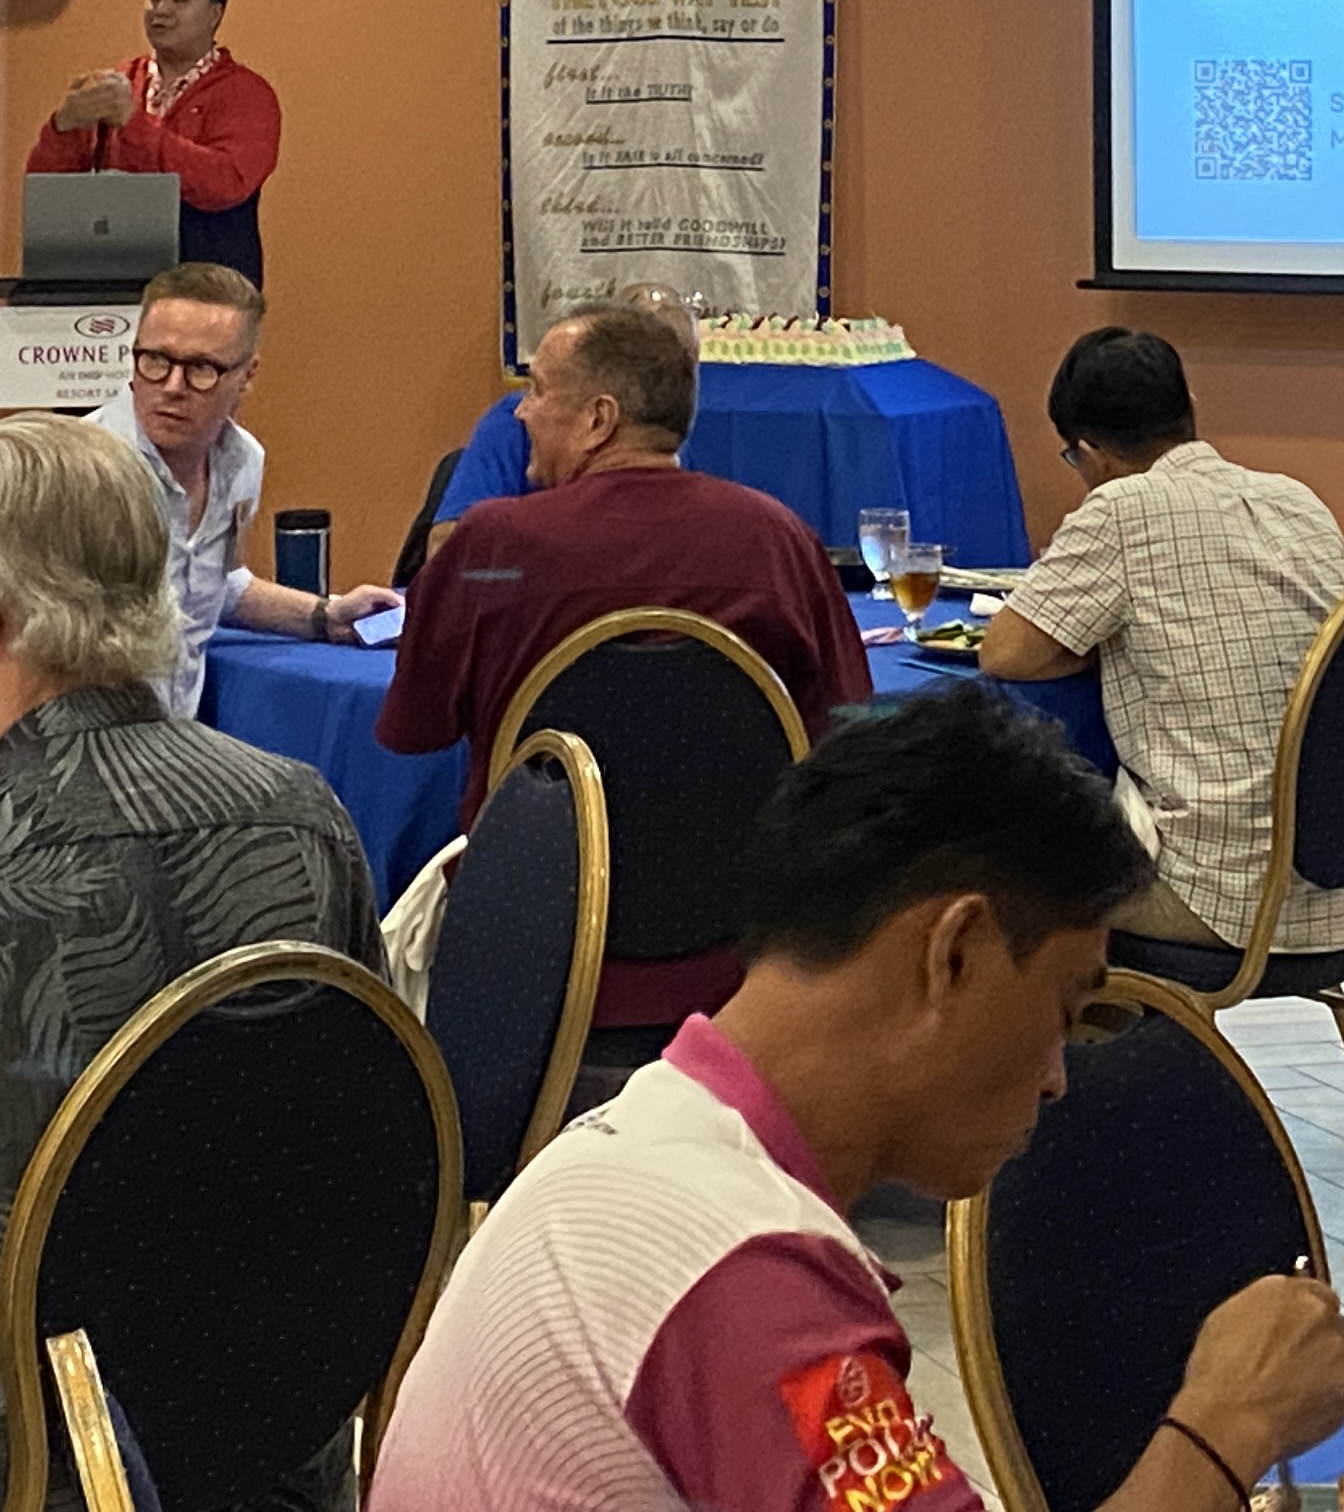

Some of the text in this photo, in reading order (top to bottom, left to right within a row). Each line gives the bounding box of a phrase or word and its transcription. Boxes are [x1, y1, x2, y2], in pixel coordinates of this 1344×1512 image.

[572, 15, 594, 35] the
[677, 218, 769, 236] GOODWILL
[17, 345, 110, 365] CROWNE
